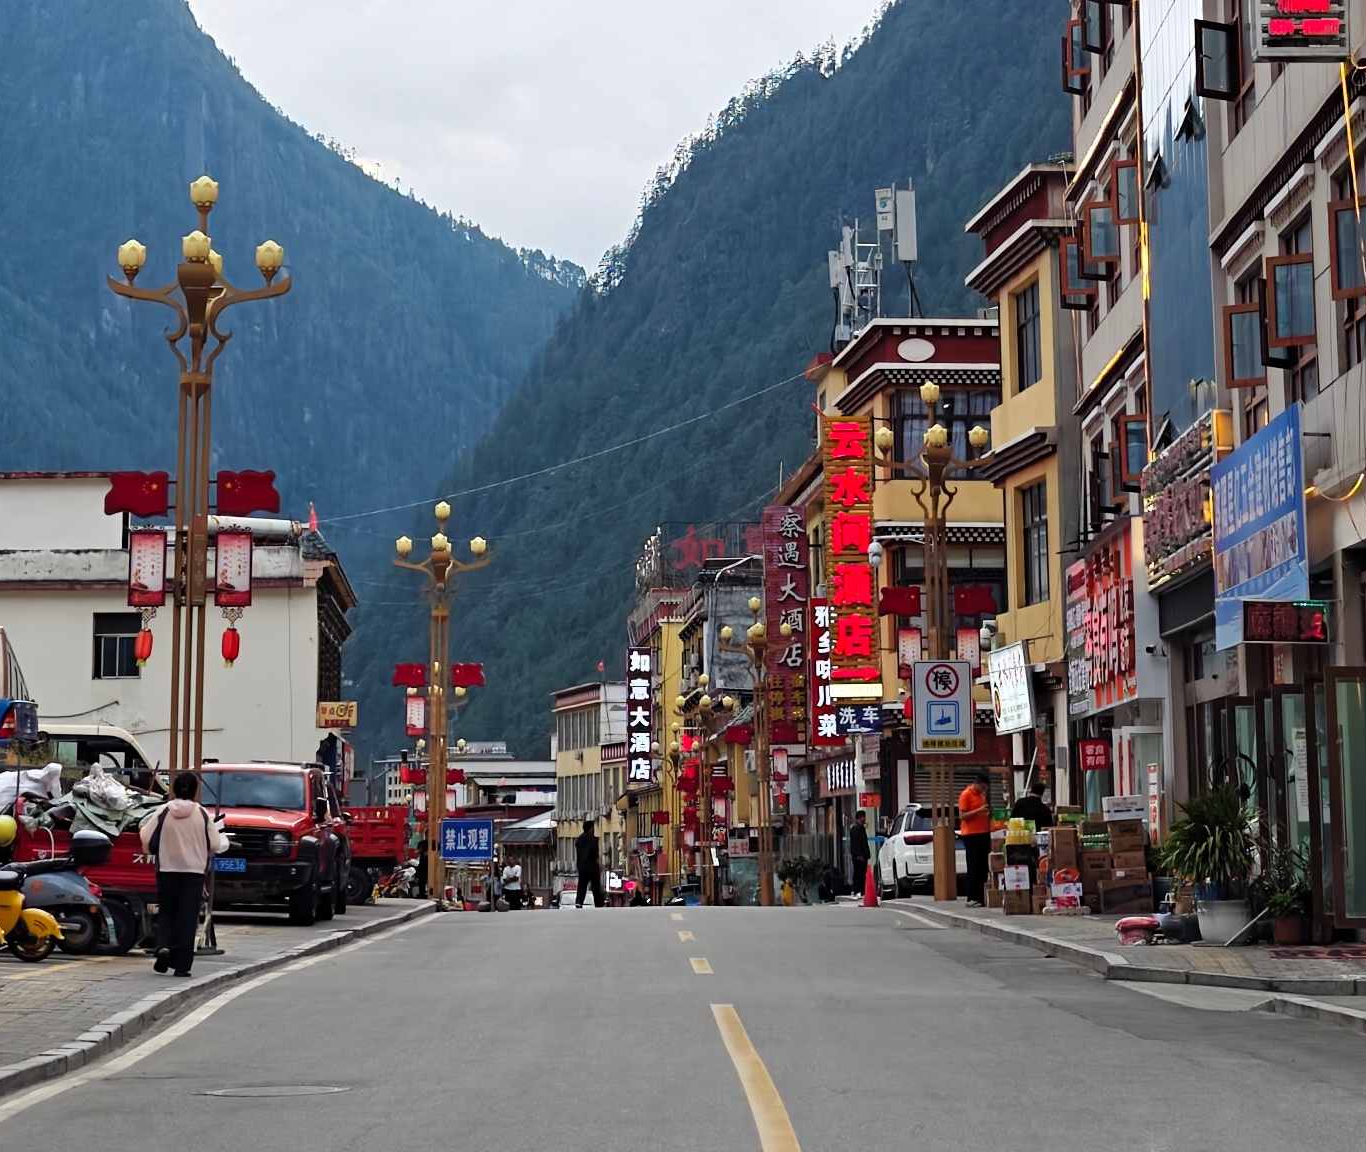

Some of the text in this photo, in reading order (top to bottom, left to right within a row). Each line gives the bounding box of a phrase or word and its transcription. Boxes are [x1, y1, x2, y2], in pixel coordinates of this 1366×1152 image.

[830, 422, 872, 656] 云水间酒店
[777, 508, 806, 667] 察遇大酒店
[629, 650, 651, 780] 如意大酒店
[839, 706, 880, 725] 洗车
[933, 671, 952, 691] 停
[445, 828, 489, 851] 禁止观望
